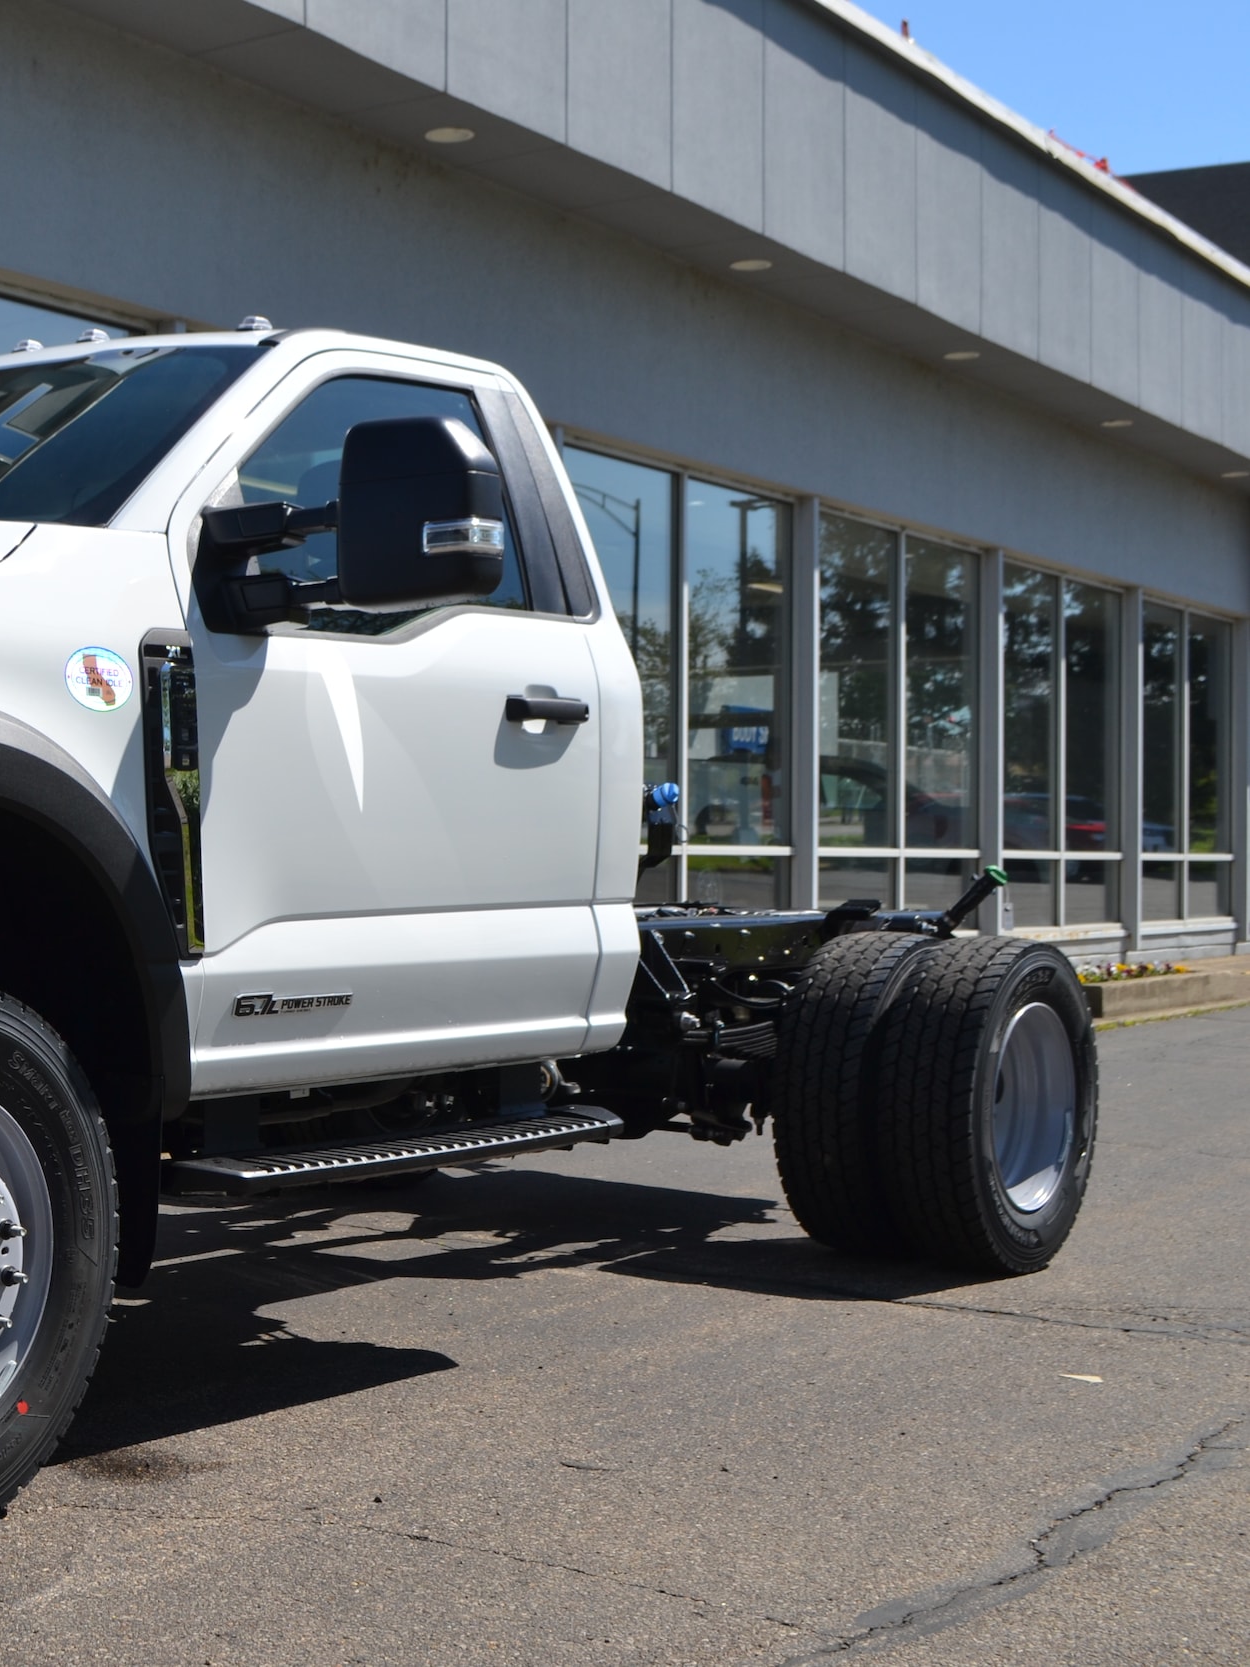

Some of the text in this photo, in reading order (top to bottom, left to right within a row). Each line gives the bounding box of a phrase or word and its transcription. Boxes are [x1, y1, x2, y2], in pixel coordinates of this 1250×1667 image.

[165, 645, 188, 658] XL
[78, 666, 120, 678] CERTIFIED
[76, 675, 123, 688] CLEAN IDLE
[234, 994, 351, 1017] 6.7L POWER STROKE
